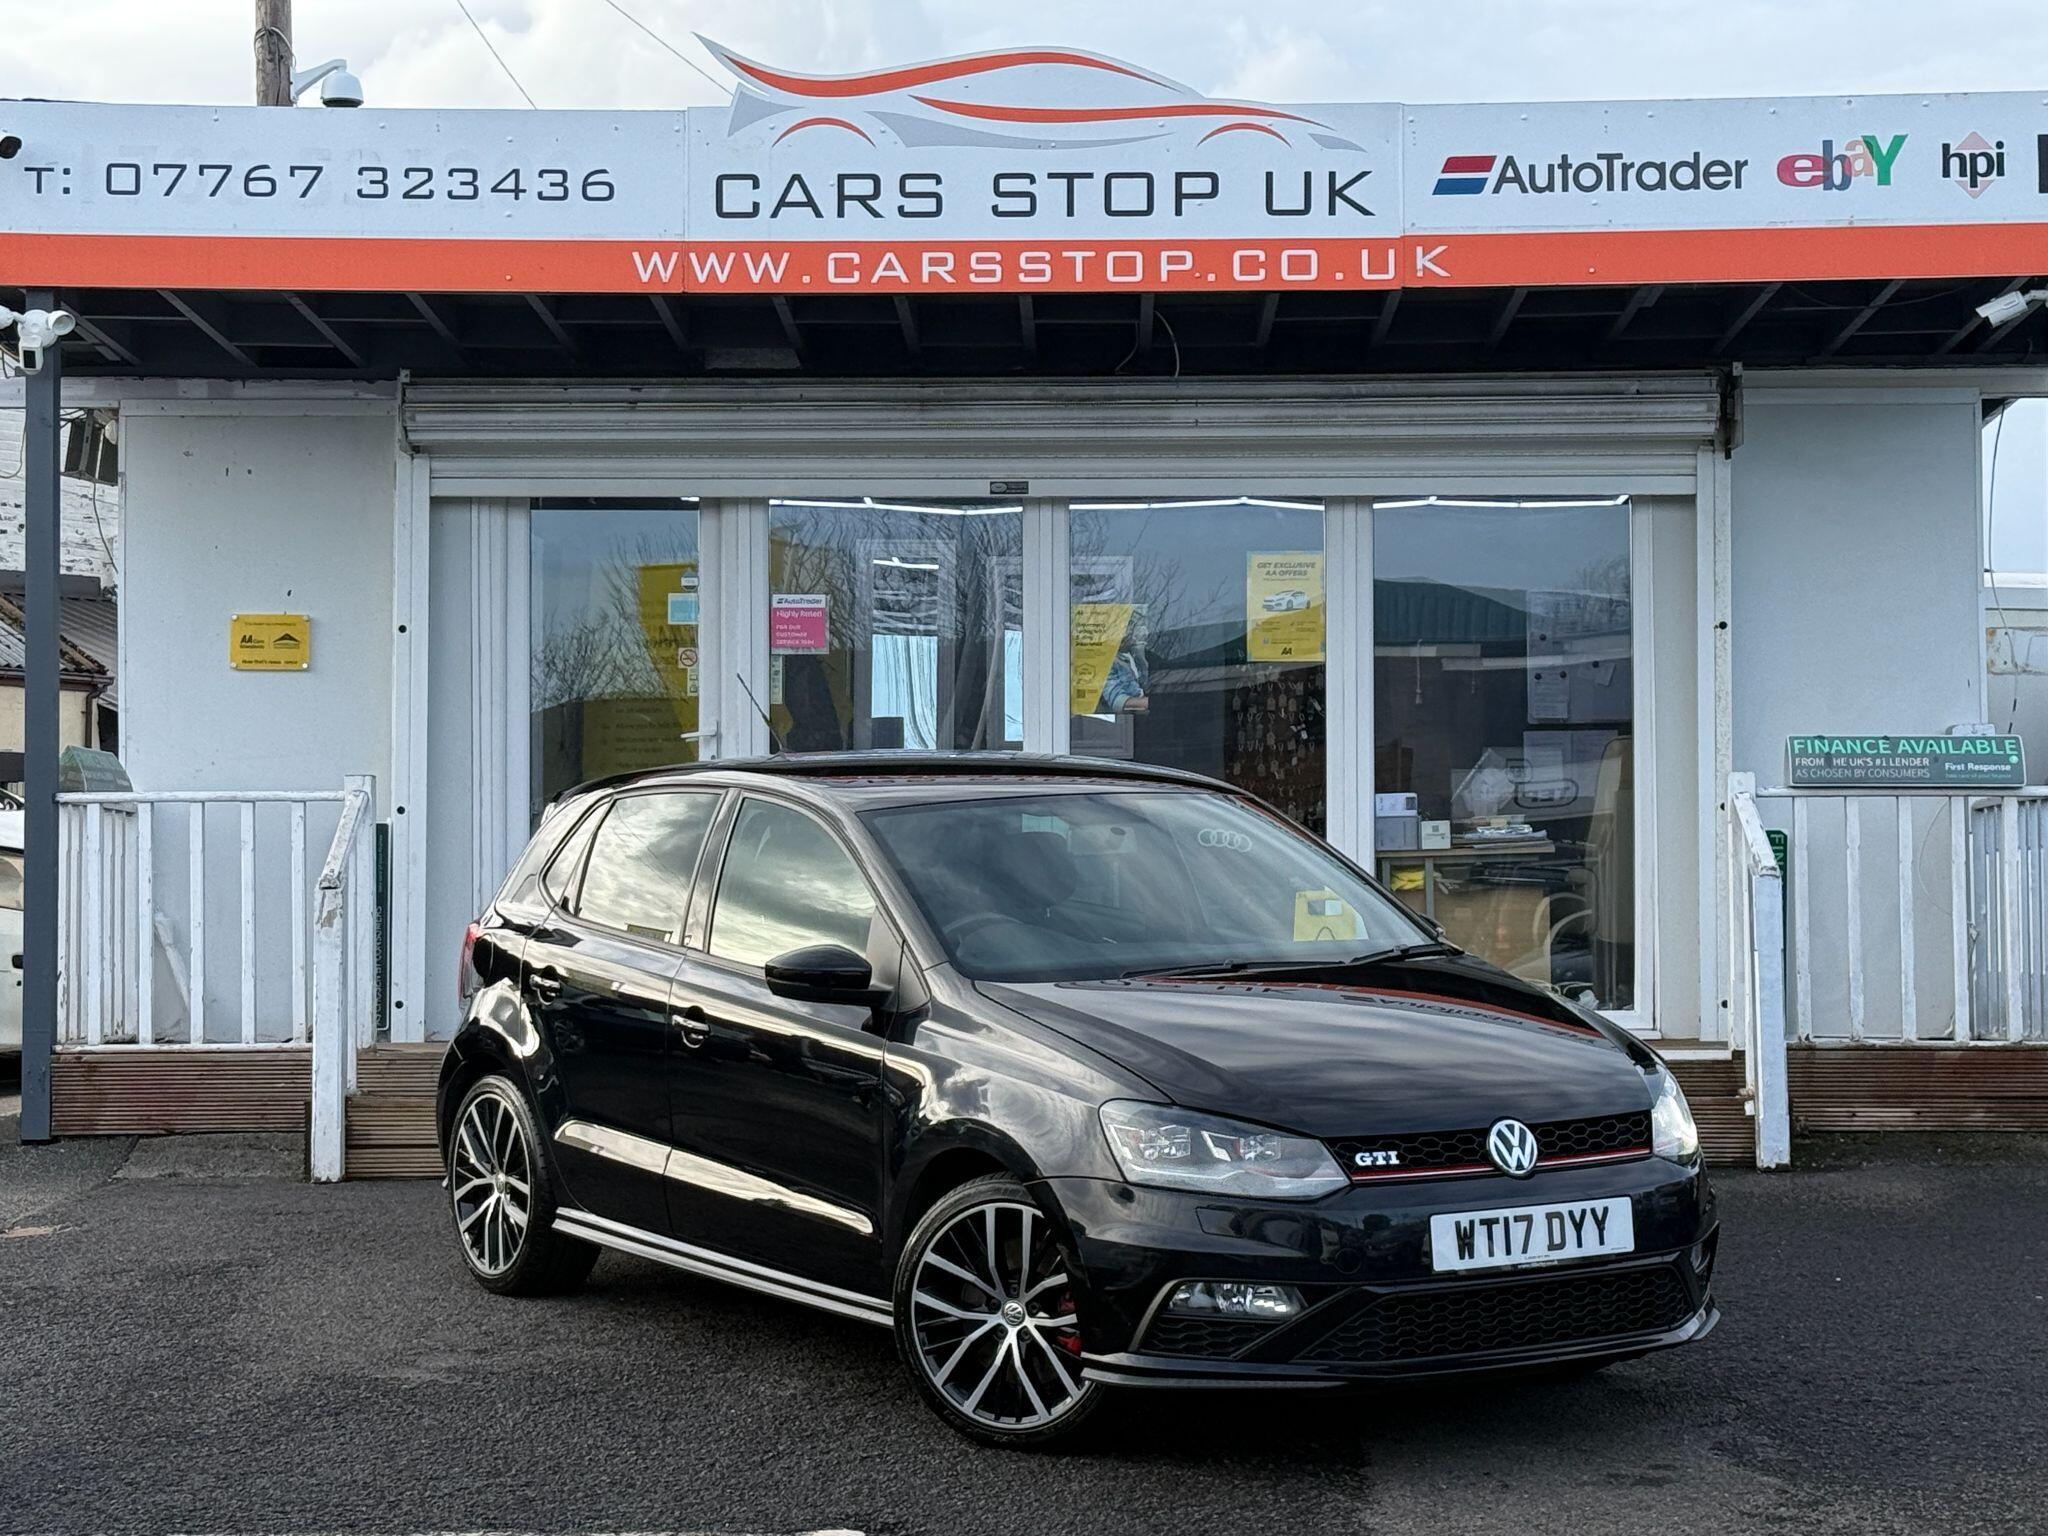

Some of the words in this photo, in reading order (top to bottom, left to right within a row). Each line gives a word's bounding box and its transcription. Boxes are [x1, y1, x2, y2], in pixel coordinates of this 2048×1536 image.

[24, 165, 72, 196] T:
[106, 162, 325, 199] 07767
[356, 166, 617, 202] 323436
[1492, 151, 1749, 195] AutoTrader
[1942, 140, 2005, 189] hpi
[715, 172, 944, 220] CARS
[991, 170, 1221, 219] STOP
[1265, 170, 1375, 218] UK
[632, 245, 1450, 285] WWW.CARSSTOP.CO.UK
[1793, 739, 1892, 755] FINANCE
[1897, 739, 2019, 755] AVAILABLE
[1795, 757, 1825, 767] FROM
[1889, 757, 1930, 767] LENDER
[1795, 768, 1809, 778] AS
[1810, 768, 1852, 778] CHOSEN
[1854, 768, 1866, 778] BY
[1867, 768, 1930, 778] CONSUMERS
[1944, 762, 1965, 771] First
[1967, 762, 2012, 773] Response
[1355, 1151, 1400, 1167] GTI
[1455, 1213, 1534, 1260] WT17
[1545, 1206, 1609, 1252] DYY
